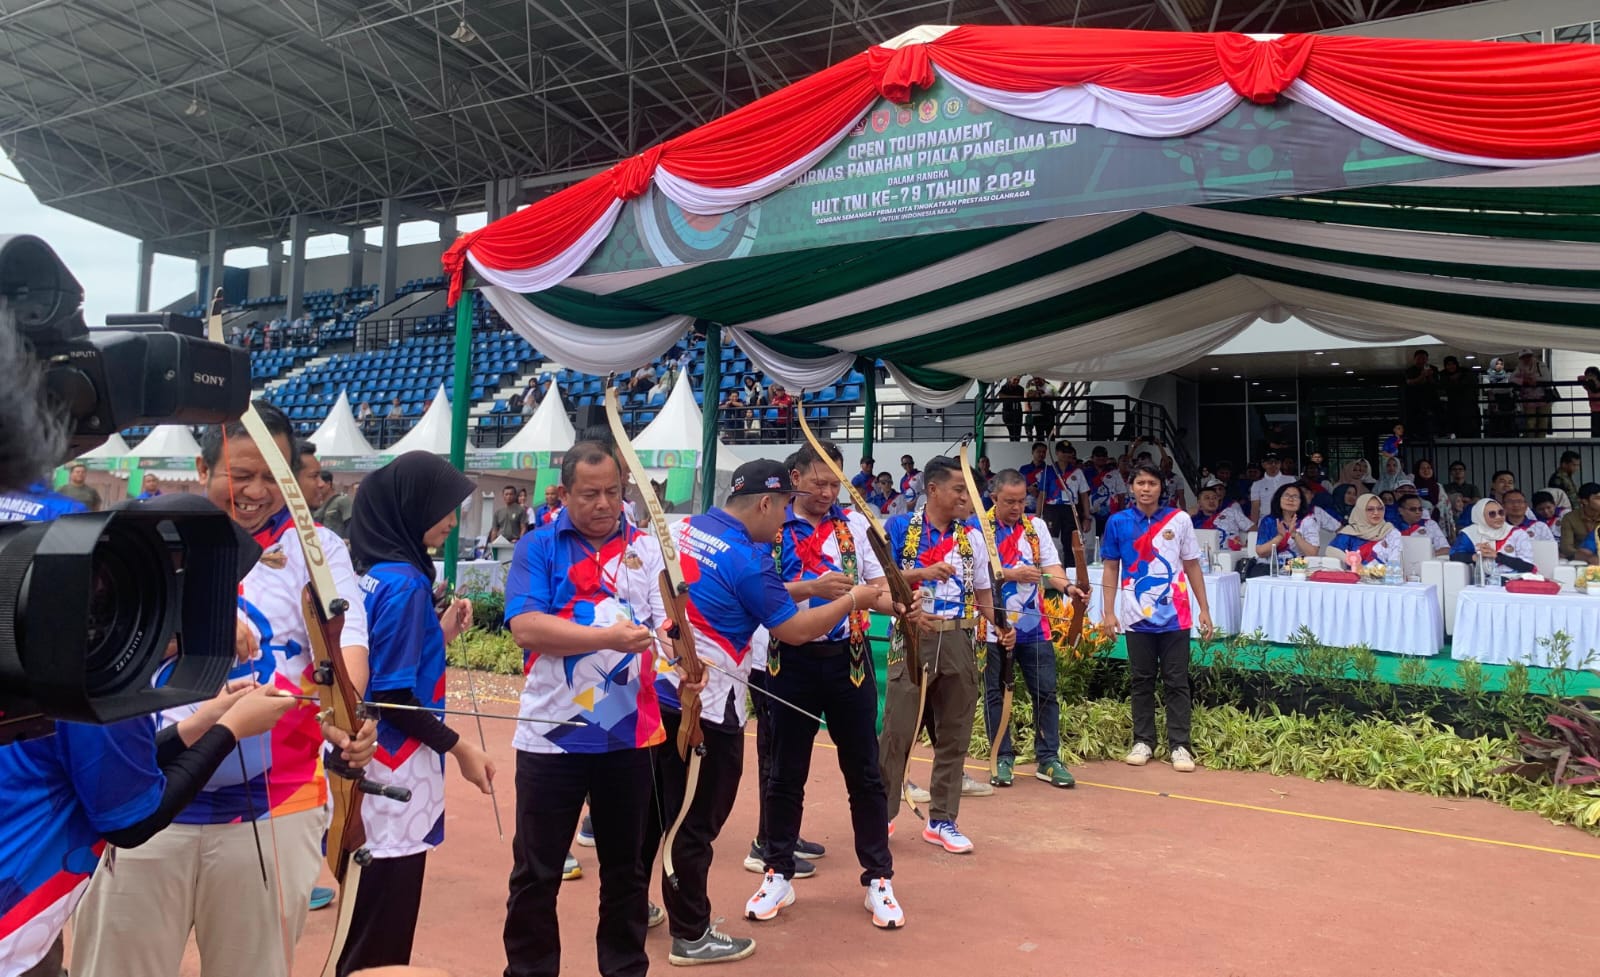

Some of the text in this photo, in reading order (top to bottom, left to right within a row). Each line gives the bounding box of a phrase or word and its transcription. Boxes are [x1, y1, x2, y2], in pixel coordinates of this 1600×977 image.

[847, 154, 913, 179] PANAHAN
[917, 146, 959, 167] PIALA
[963, 132, 1046, 160] PANGLIMA
[1050, 127, 1077, 145] TNI
[848, 121, 993, 160] OPEN TOURNAMENT
[811, 197, 840, 217] HUT
[843, 193, 868, 212] TNI
[926, 176, 981, 201] TAHUN
[987, 169, 1036, 191] 2024
[887, 169, 949, 186] DALAM RANGKA
[815, 215, 842, 225] DENGAN
[842, 210, 876, 222] SEMANGAT
[876, 207, 897, 216] PRIMA
[914, 200, 958, 211] TINGKATKAN
[958, 195, 991, 205] PRESTASI
[991, 190, 1031, 200] OLAHRAGA
[878, 207, 957, 223] UNTUK INDONESIA MAJU
[193, 372, 225, 386] SONY
[281, 469, 325, 567] CARTEL
[649, 498, 676, 561] CARTEL
